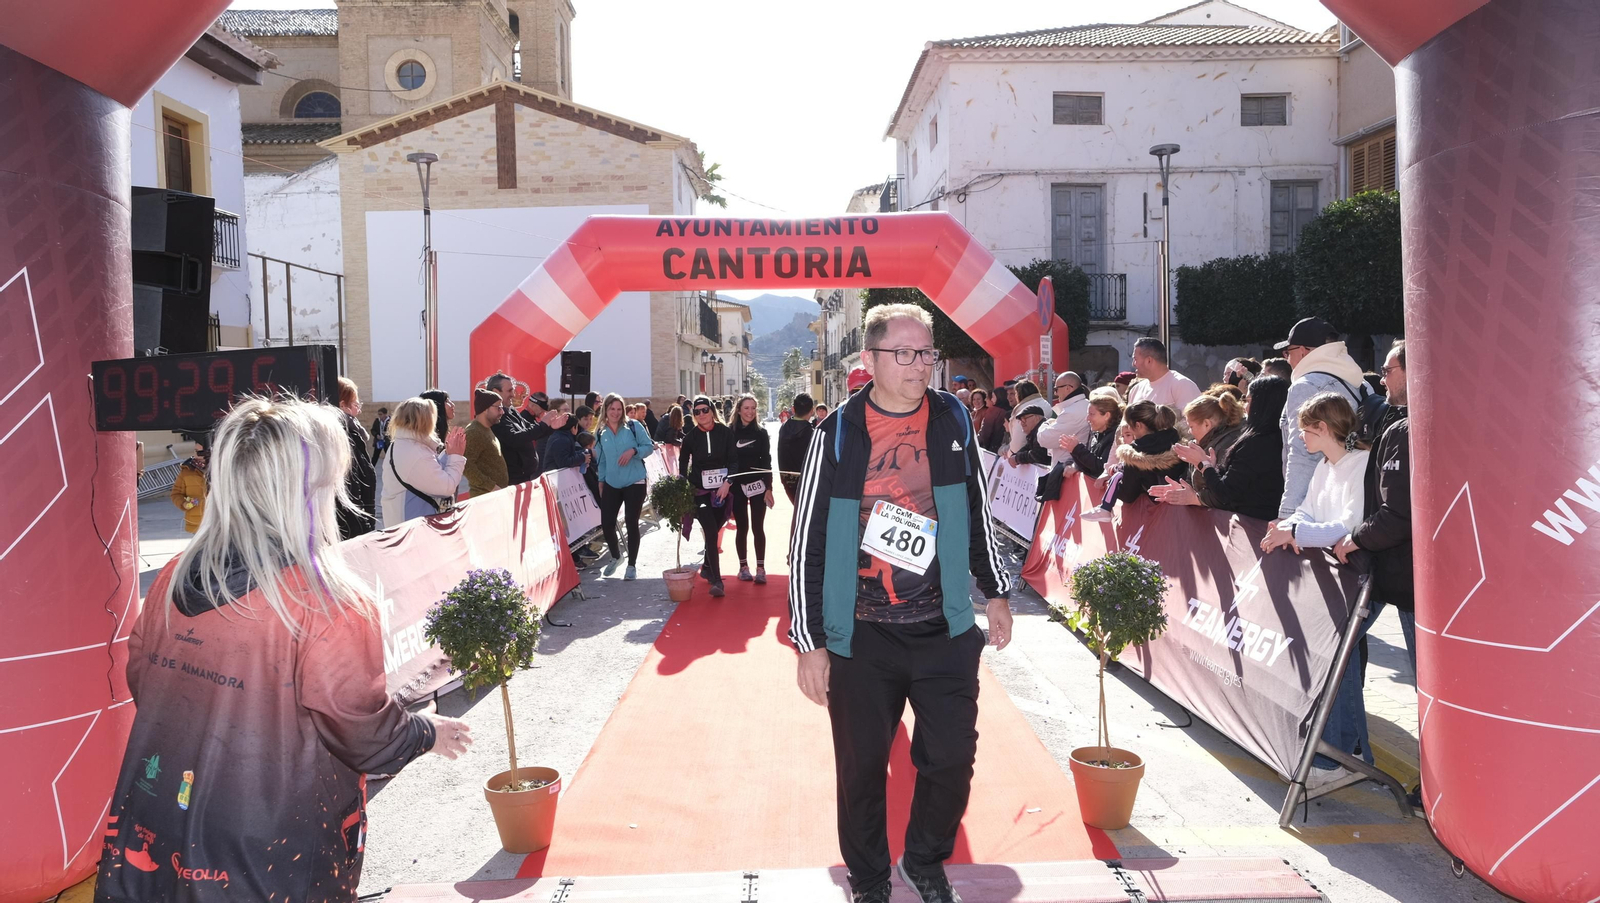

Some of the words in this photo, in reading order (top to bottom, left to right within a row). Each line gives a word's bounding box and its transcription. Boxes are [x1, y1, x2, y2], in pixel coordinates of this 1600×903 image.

[655, 216, 879, 237] AYUNTAMIENTO
[662, 245, 872, 280] CANTORIA
[708, 475, 723, 484] 517
[747, 482, 762, 493] 468
[880, 510, 889, 519] LA
[891, 514, 921, 531] POLVORA
[886, 503, 895, 511] IV
[896, 508, 913, 519] CxM
[880, 525, 926, 557] 480
[1181, 597, 1294, 667] TEAMERGY
[161, 657, 176, 669] DE
[181, 661, 245, 690] ALMANZORA
[177, 866, 229, 881] VEOLIA
